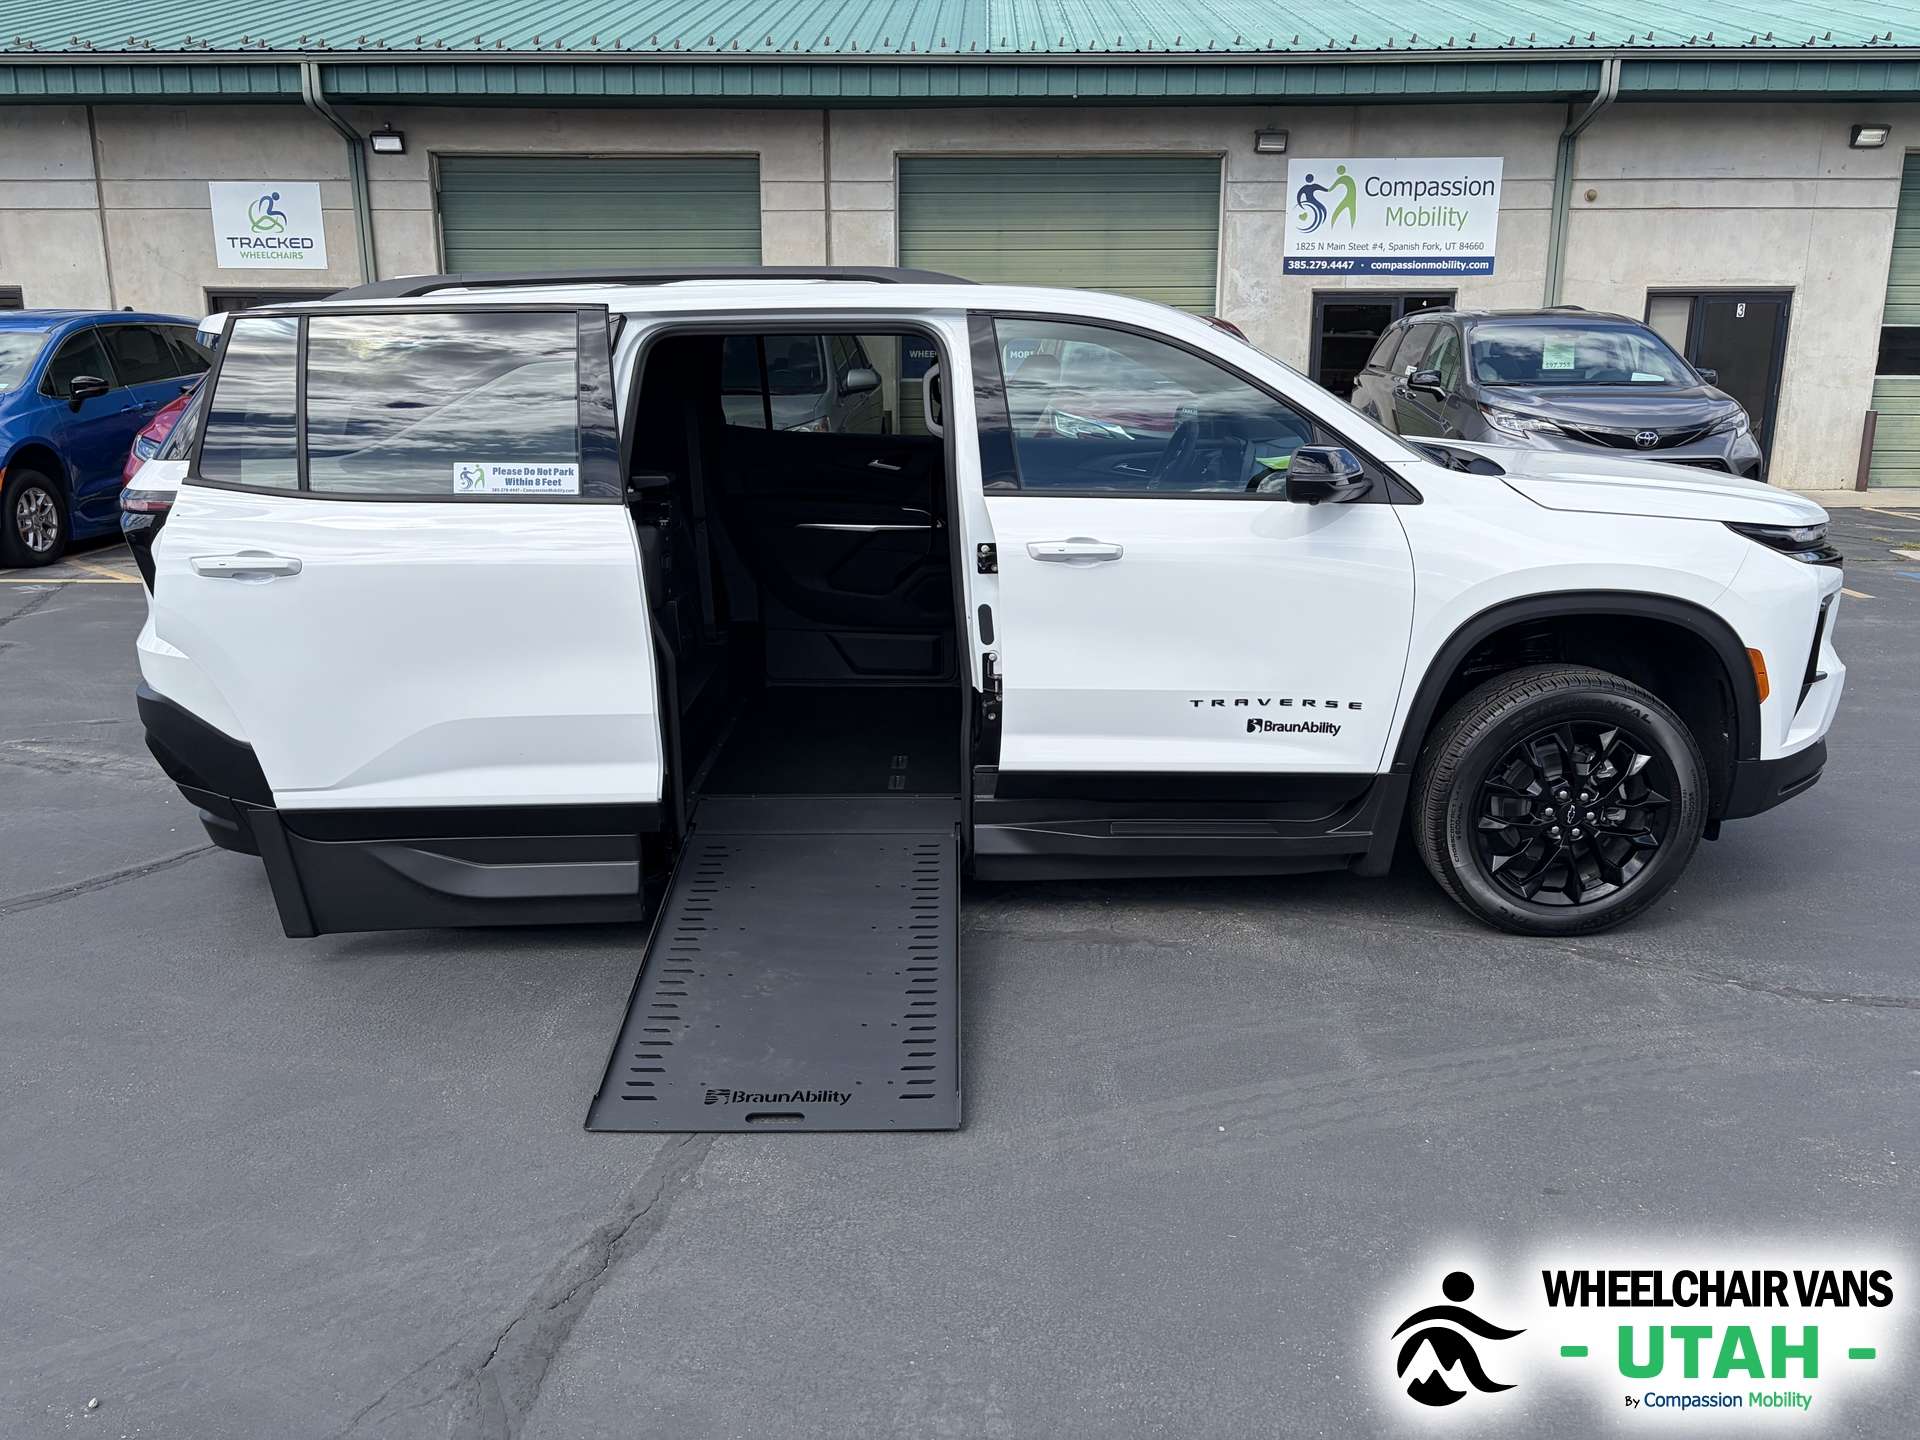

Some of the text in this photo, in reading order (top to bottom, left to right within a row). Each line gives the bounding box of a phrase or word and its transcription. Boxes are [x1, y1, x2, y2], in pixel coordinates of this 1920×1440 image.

[1364, 175, 1495, 201] Compassion
[1385, 206, 1469, 231] Mobility
[226, 237, 314, 249] TRACKED
[1295, 242, 1316, 251] 1825
[1318, 242, 1324, 251] N
[1326, 242, 1346, 251] Main
[1371, 242, 1386, 253] #4,
[1388, 242, 1420, 253] Spanish
[1422, 242, 1442, 252] Fork,
[1445, 242, 1457, 251] UT
[1459, 242, 1485, 251] 84660
[240, 251, 304, 260] WHEELCHAIRS
[1287, 260, 1489, 271] 385.279.4447 compassionmobility.com
[1737, 303, 1744, 317] 3
[492, 467, 575, 476] Please Do Not Park
[504, 477, 562, 486] Within 8 Feet
[1190, 698, 1363, 710] TRAVERSE
[1263, 720, 1342, 737] BraunAbility
[732, 1090, 852, 1106] BraunAbility
